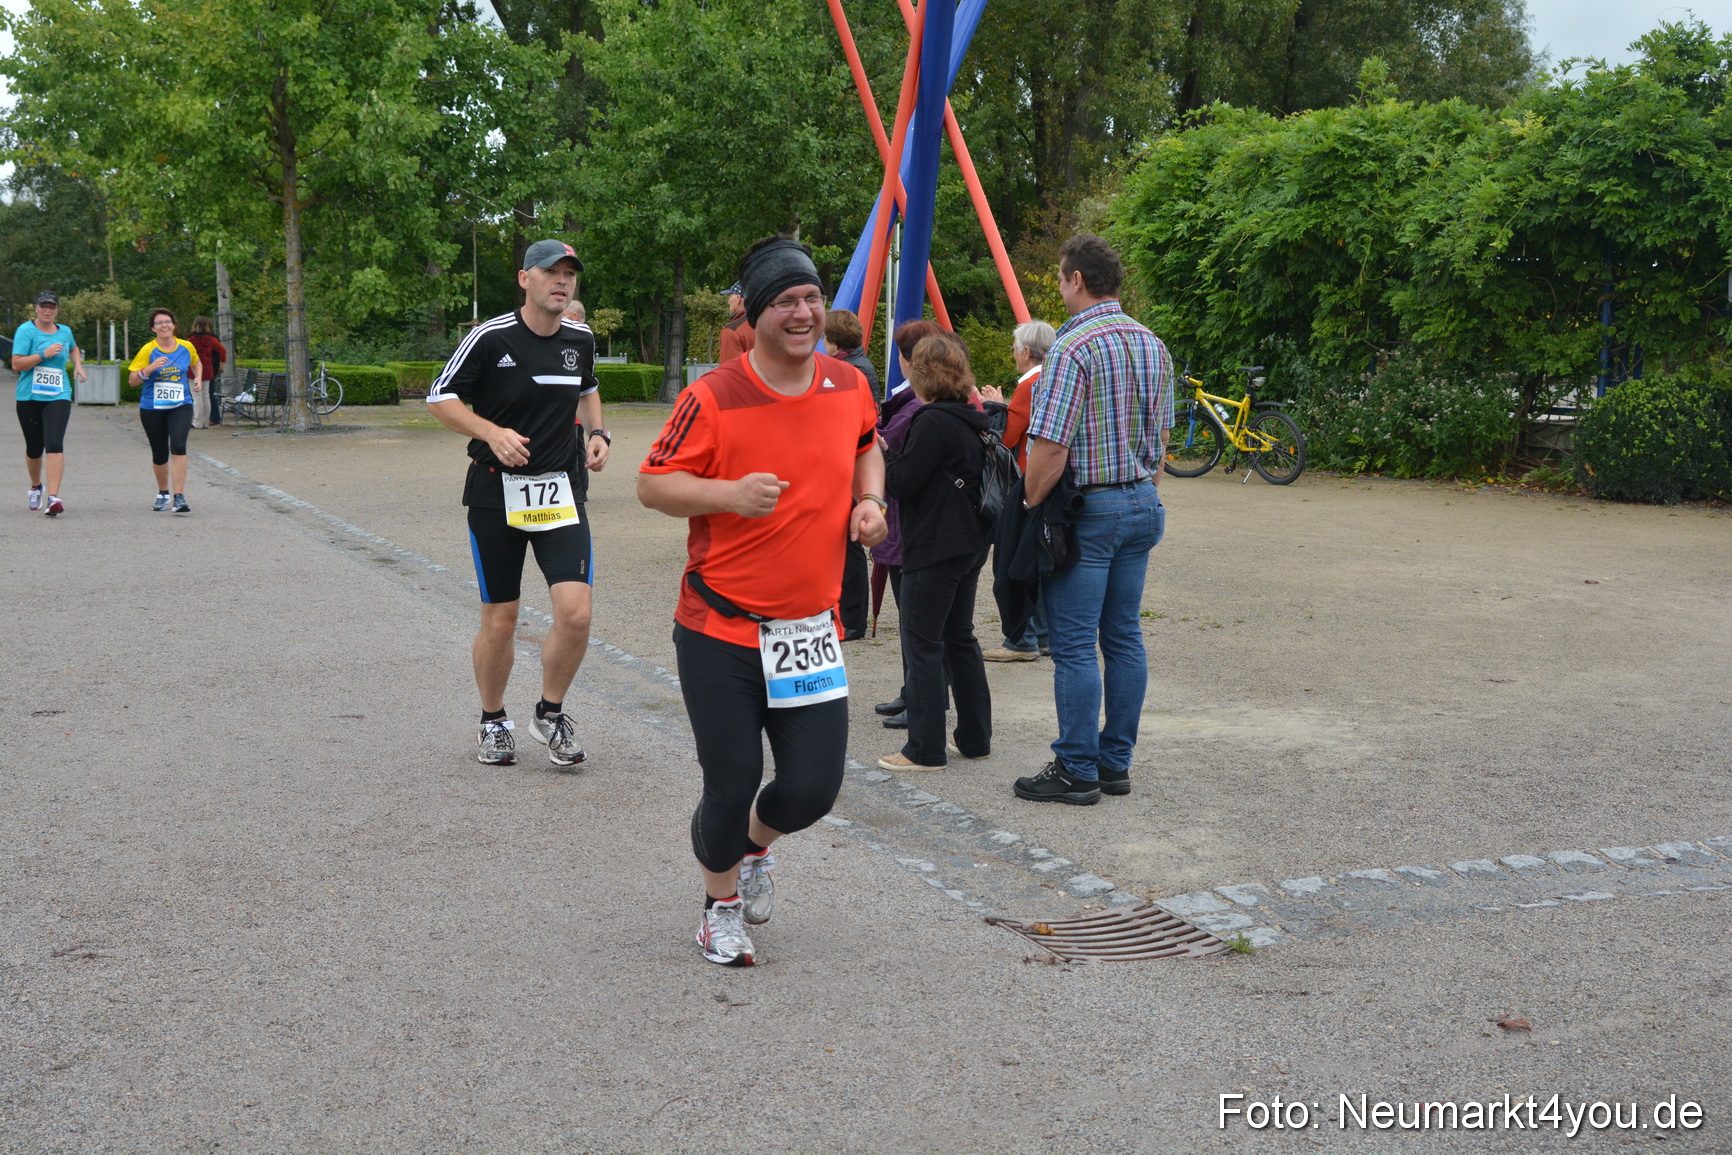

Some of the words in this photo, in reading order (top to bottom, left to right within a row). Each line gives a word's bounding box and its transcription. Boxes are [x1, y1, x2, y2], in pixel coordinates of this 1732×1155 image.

[36, 372, 61, 386] 2508
[157, 388, 181, 400] 2507
[520, 481, 560, 507] 172
[523, 511, 562, 523] Matthias
[795, 621, 830, 634] Neumarkt
[772, 632, 837, 673] 2536
[794, 676, 834, 694] Florian
